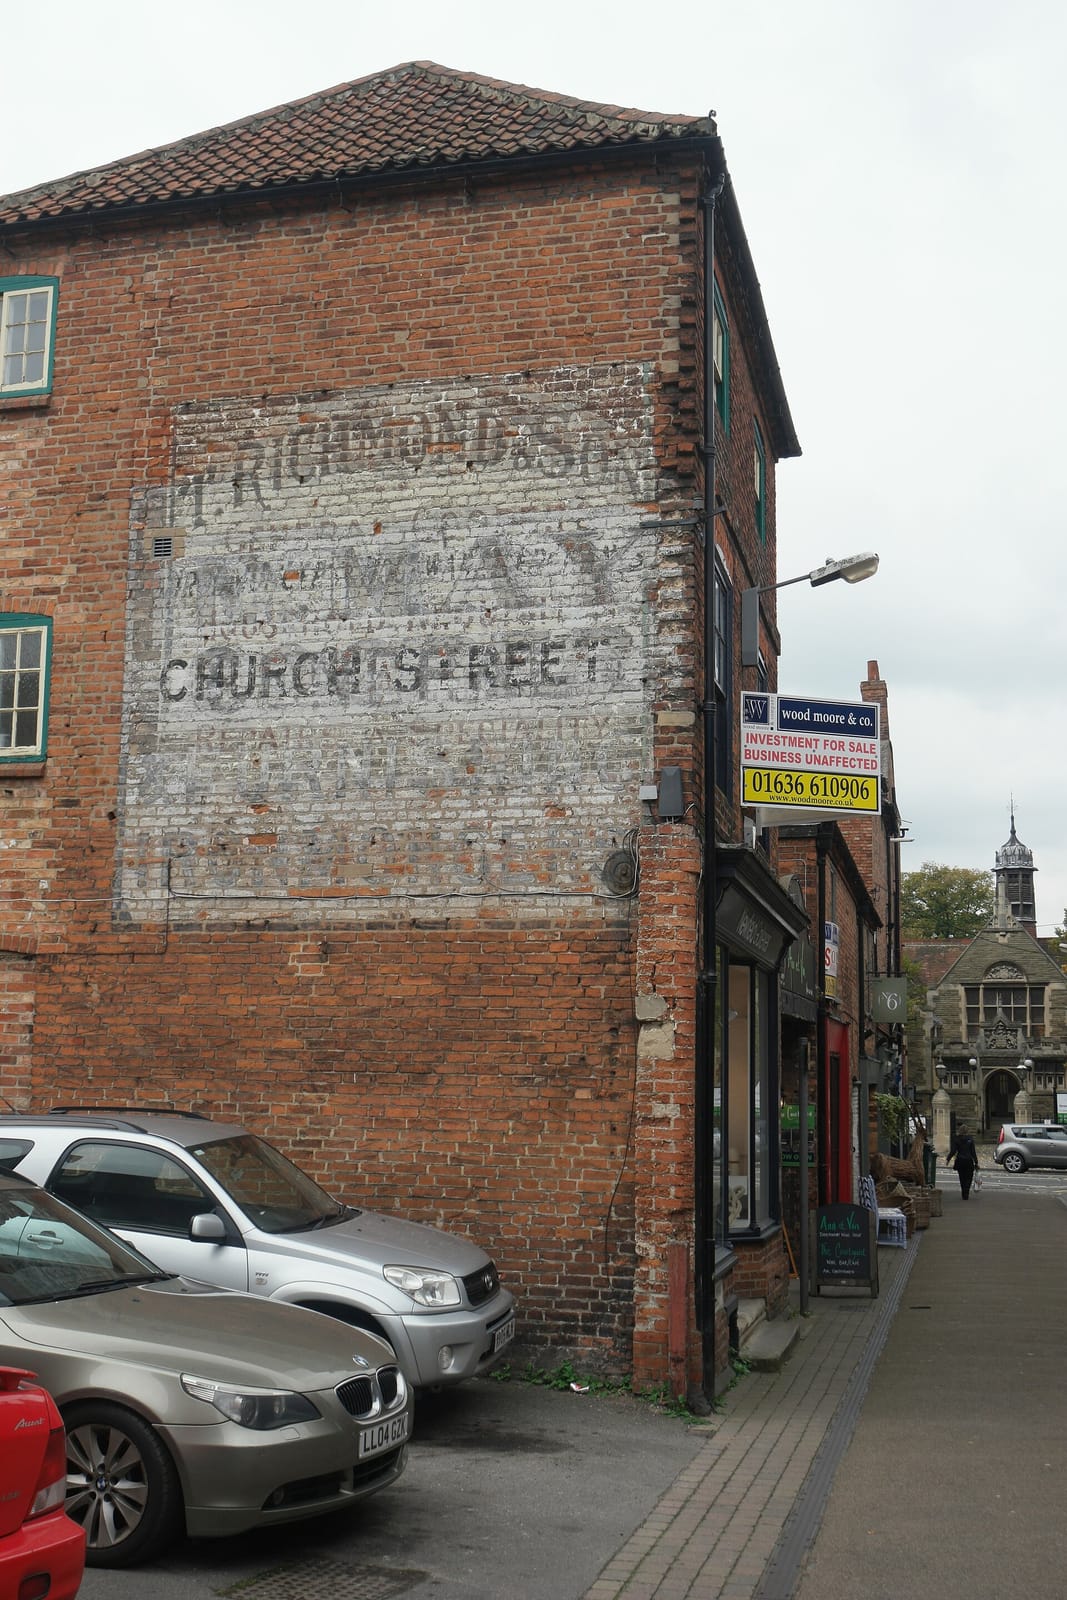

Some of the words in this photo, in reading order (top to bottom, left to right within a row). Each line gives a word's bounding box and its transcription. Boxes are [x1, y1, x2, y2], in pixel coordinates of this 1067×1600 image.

[159, 649, 362, 702] CHURCH
[781, 708, 811, 722] wood
[813, 712, 845, 725] moore
[847, 712, 857, 726] &
[859, 715, 873, 727] co.
[745, 732, 820, 750] INVESTMENT
[823, 739, 846, 752] FOR
[848, 741, 877, 755] SALE
[744, 748, 801, 764] BUSINESS
[805, 754, 878, 770] UNAFFECTED
[752, 771, 804, 795] 01636
[809, 775, 870, 800] 610906
[769, 795, 854, 807] www.woodmoore.co.uk
[363, 1423, 390, 1453] LL04
